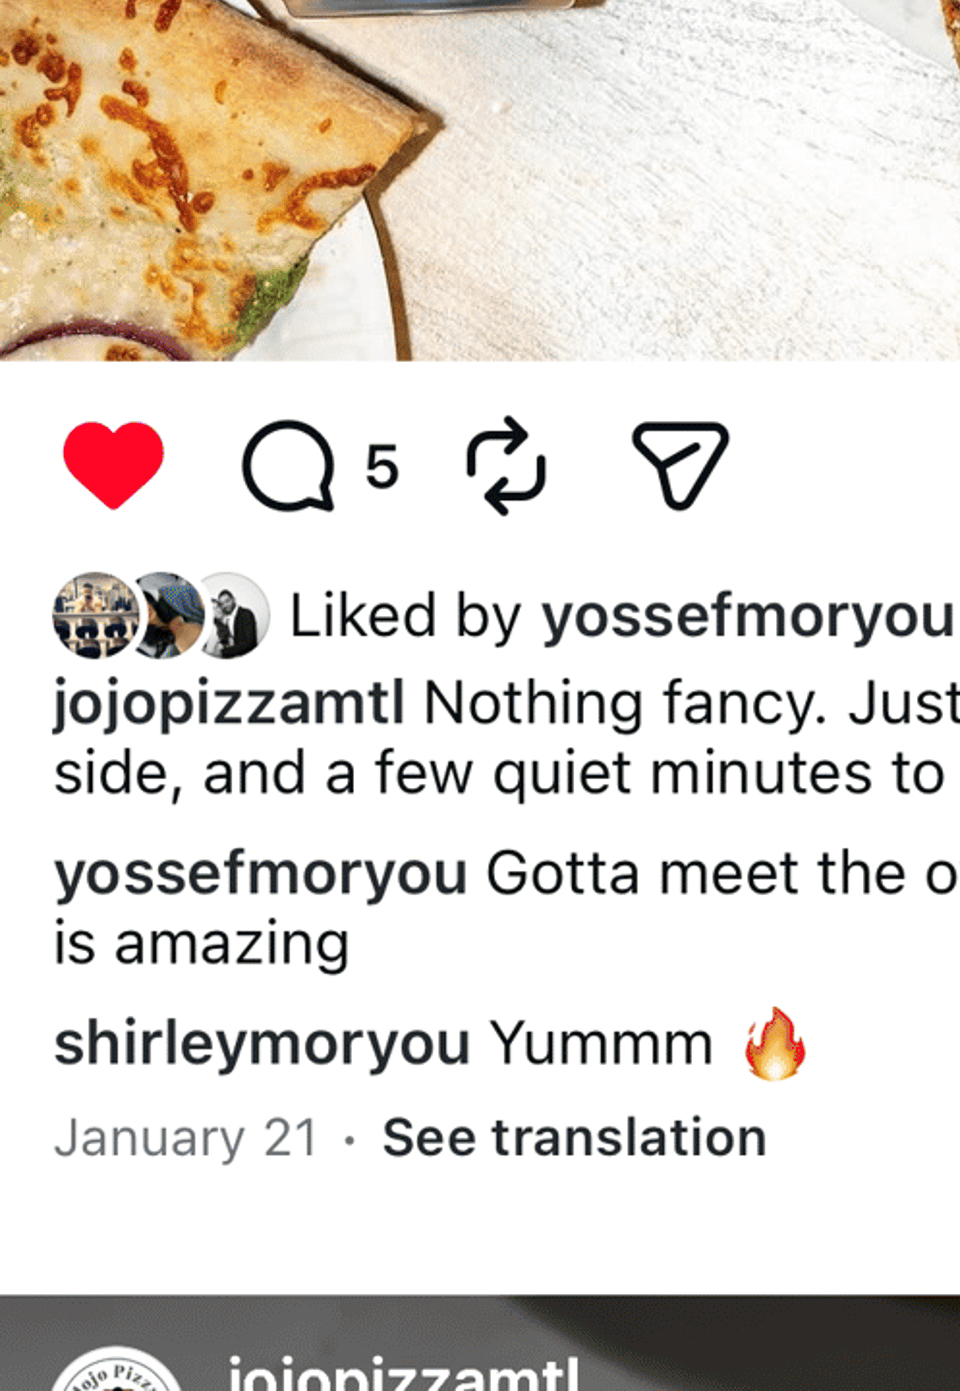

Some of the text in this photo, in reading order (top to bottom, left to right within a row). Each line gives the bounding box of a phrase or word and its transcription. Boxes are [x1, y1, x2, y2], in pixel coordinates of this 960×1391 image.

[366, 443, 400, 490] 5
[292, 590, 436, 638] Liked
[458, 590, 523, 649] by
[541, 590, 954, 649] yossefmoryou
[52, 676, 404, 736] jojopizzamtl
[427, 677, 642, 736] Nothing
[662, 677, 826, 736] fancy.
[54, 747, 182, 805] side,
[204, 747, 305, 795] and
[326, 759, 355, 795] a
[374, 747, 474, 795] few
[494, 747, 632, 806] quiet
[653, 747, 873, 795] minutes
[891, 751, 945, 795] to
[54, 848, 467, 906] yossefmoryou
[488, 848, 639, 896] Gotta
[661, 851, 799, 896] meet
[817, 848, 906, 896] the
[56, 917, 348, 977] is amazing
[54, 1016, 712, 1076] shirleymoryou Yummm
[54, 1115, 766, 1166] January 21 See translation
[113, 1364, 157, 1391] Pizz
